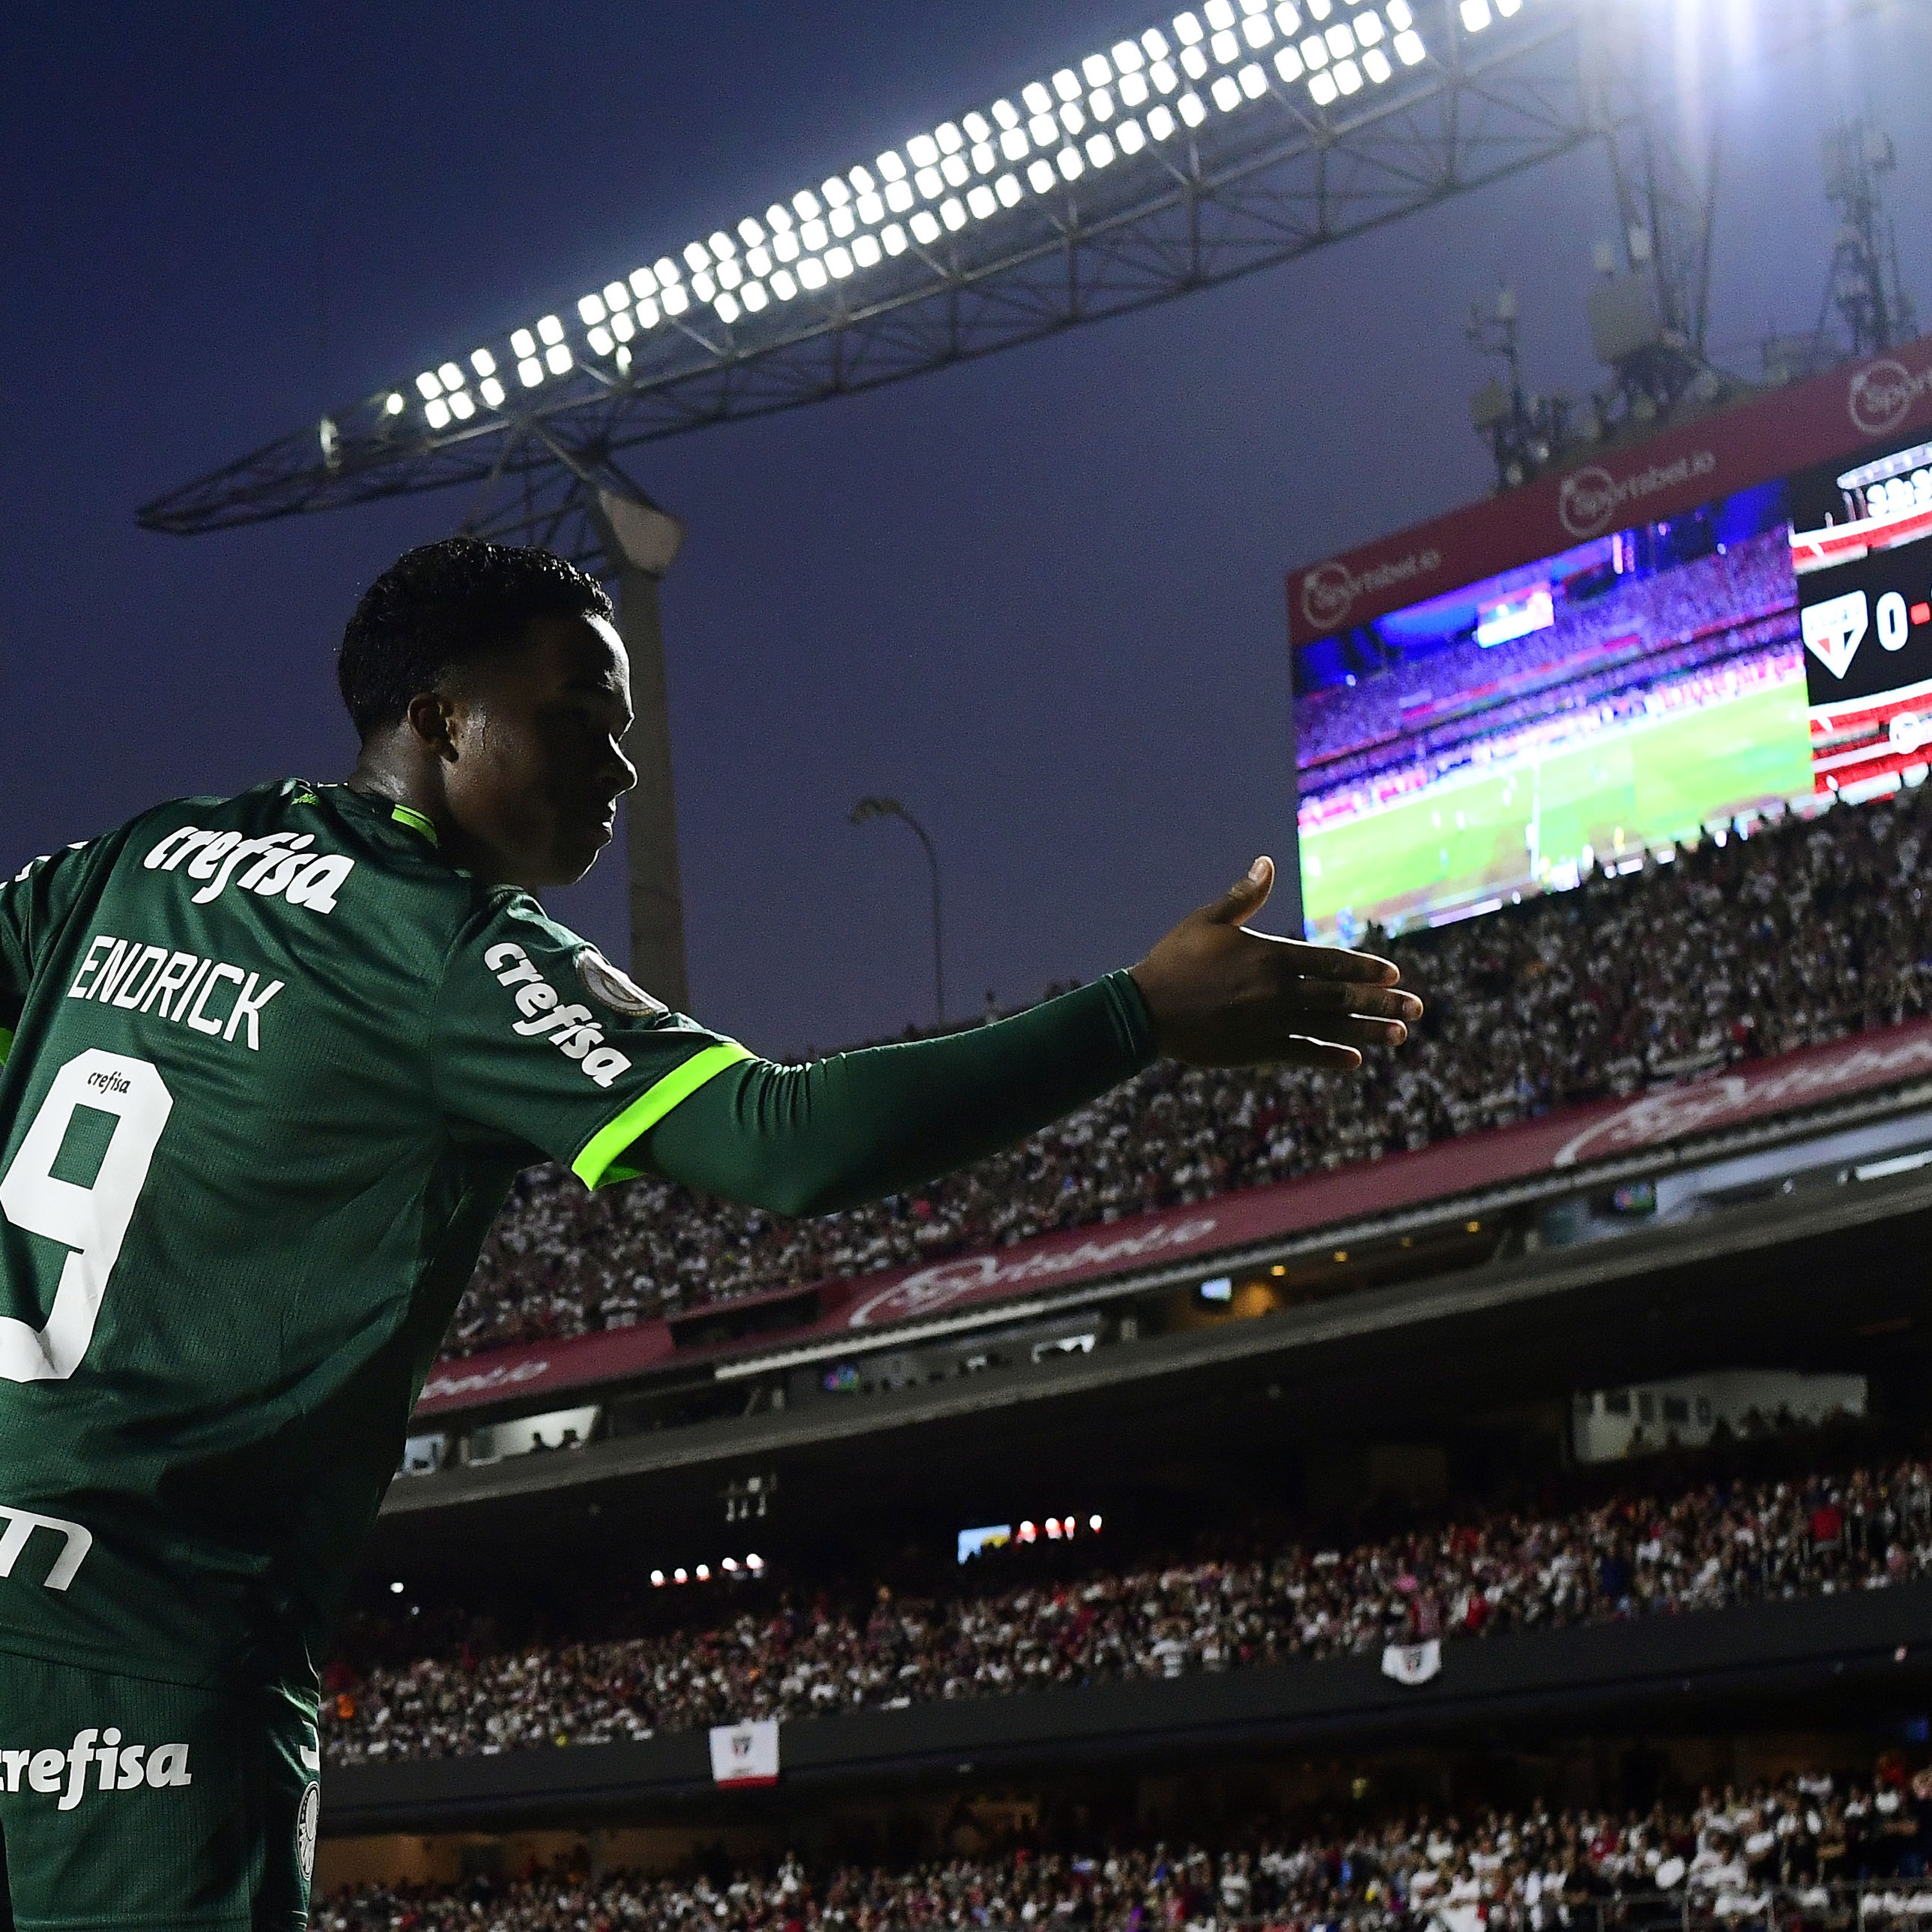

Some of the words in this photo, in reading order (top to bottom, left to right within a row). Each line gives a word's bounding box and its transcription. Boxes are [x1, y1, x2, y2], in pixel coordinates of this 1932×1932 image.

[1877, 591, 1908, 651] 0
[144, 826, 354, 914] crefisa
[67, 935, 285, 1050] ENDRICK
[484, 942, 632, 1088] crefisa
[87, 1071, 131, 1094] crefisa
[0, 1048, 173, 1383] 9
[0, 1727, 192, 1810] refisa
